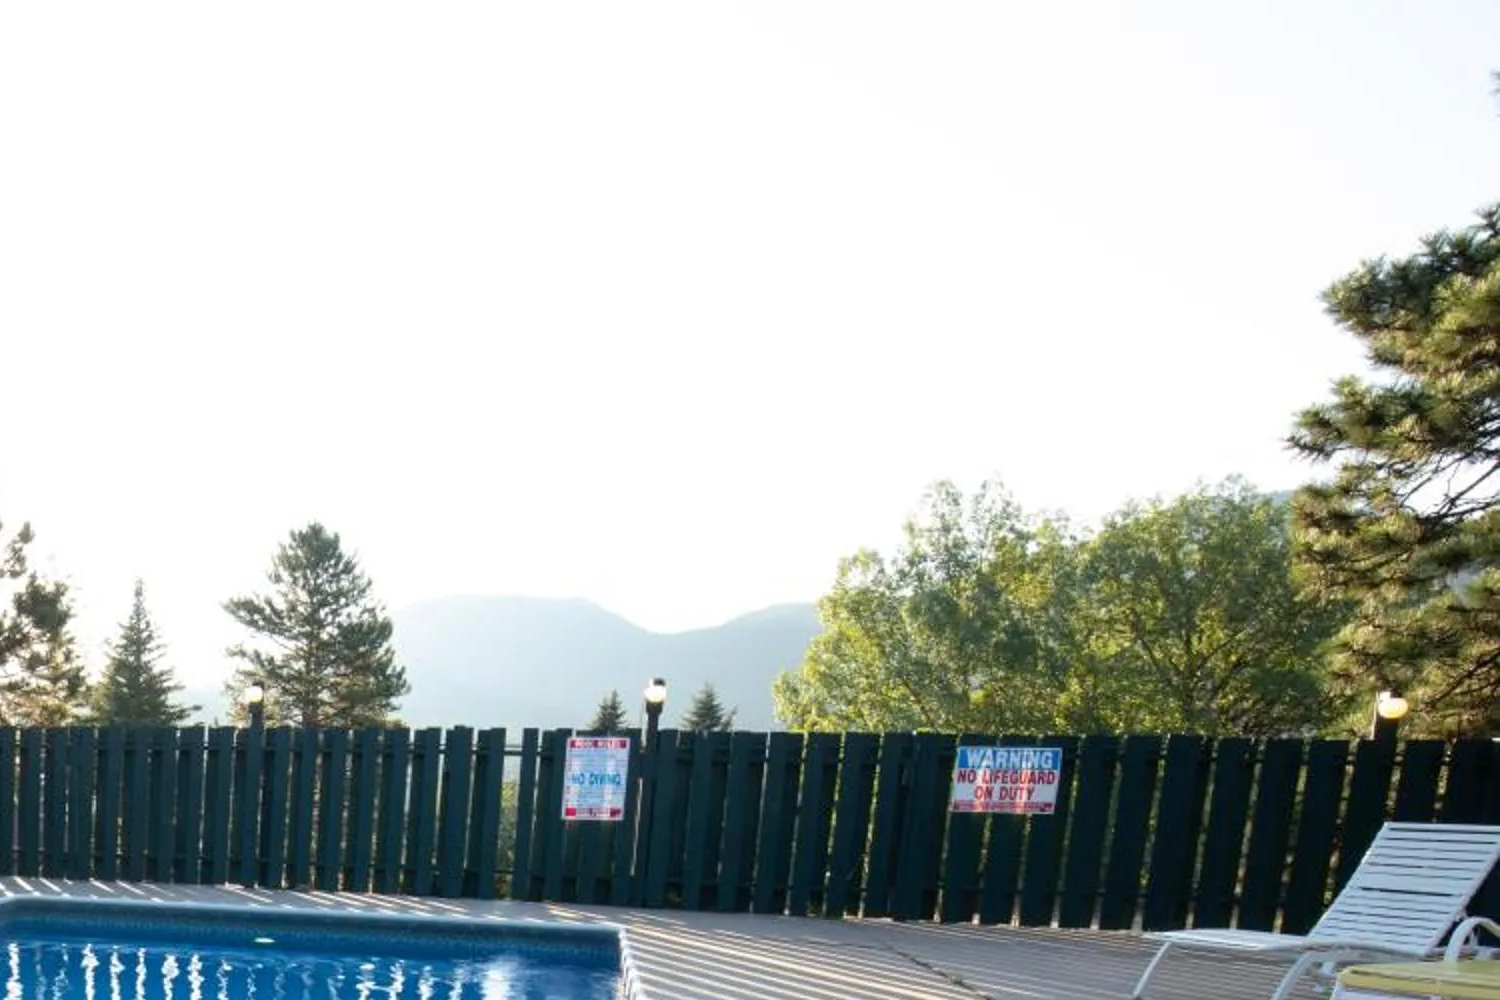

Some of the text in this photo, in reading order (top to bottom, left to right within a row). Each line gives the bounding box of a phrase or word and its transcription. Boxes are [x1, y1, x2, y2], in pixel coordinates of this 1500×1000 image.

[966, 748, 1053, 768] WARNING
[957, 769, 1056, 784] NO LIFEGUARD
[974, 786, 1035, 800] ON DUTY
